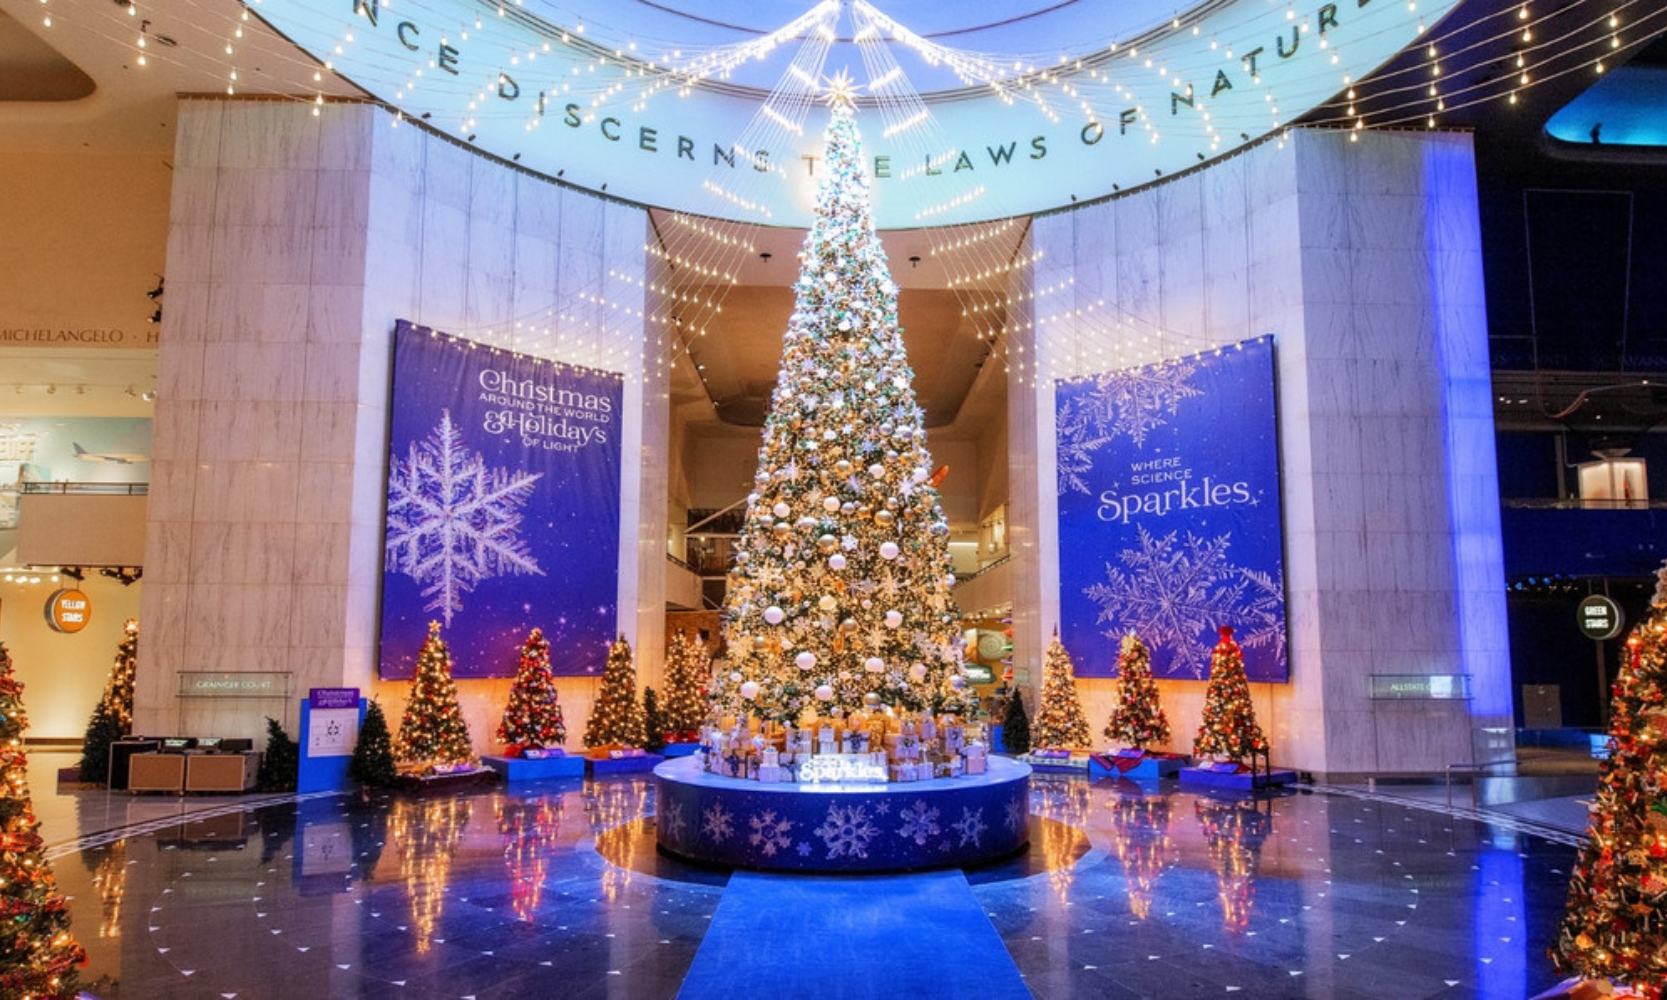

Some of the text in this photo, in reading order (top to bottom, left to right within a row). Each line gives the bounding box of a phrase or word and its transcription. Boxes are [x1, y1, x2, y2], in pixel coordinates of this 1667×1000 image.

[498, 73, 768, 172] DISCERNS
[802, 154, 891, 177] TE
[926, 136, 1047, 176] LAWS
[1081, 108, 1137, 145] OF
[1171, 0, 1372, 115] NATUR
[479, 369, 612, 413] Christmas
[479, 392, 610, 423] AROUND THE WORLD
[522, 436, 579, 453] OF LIGHT
[1131, 457, 1182, 472] WHERE
[1131, 468, 1193, 486] SCIENCE
[1097, 476, 1251, 525] Sparkles
[1390, 682, 1425, 691] ALLSTATE
